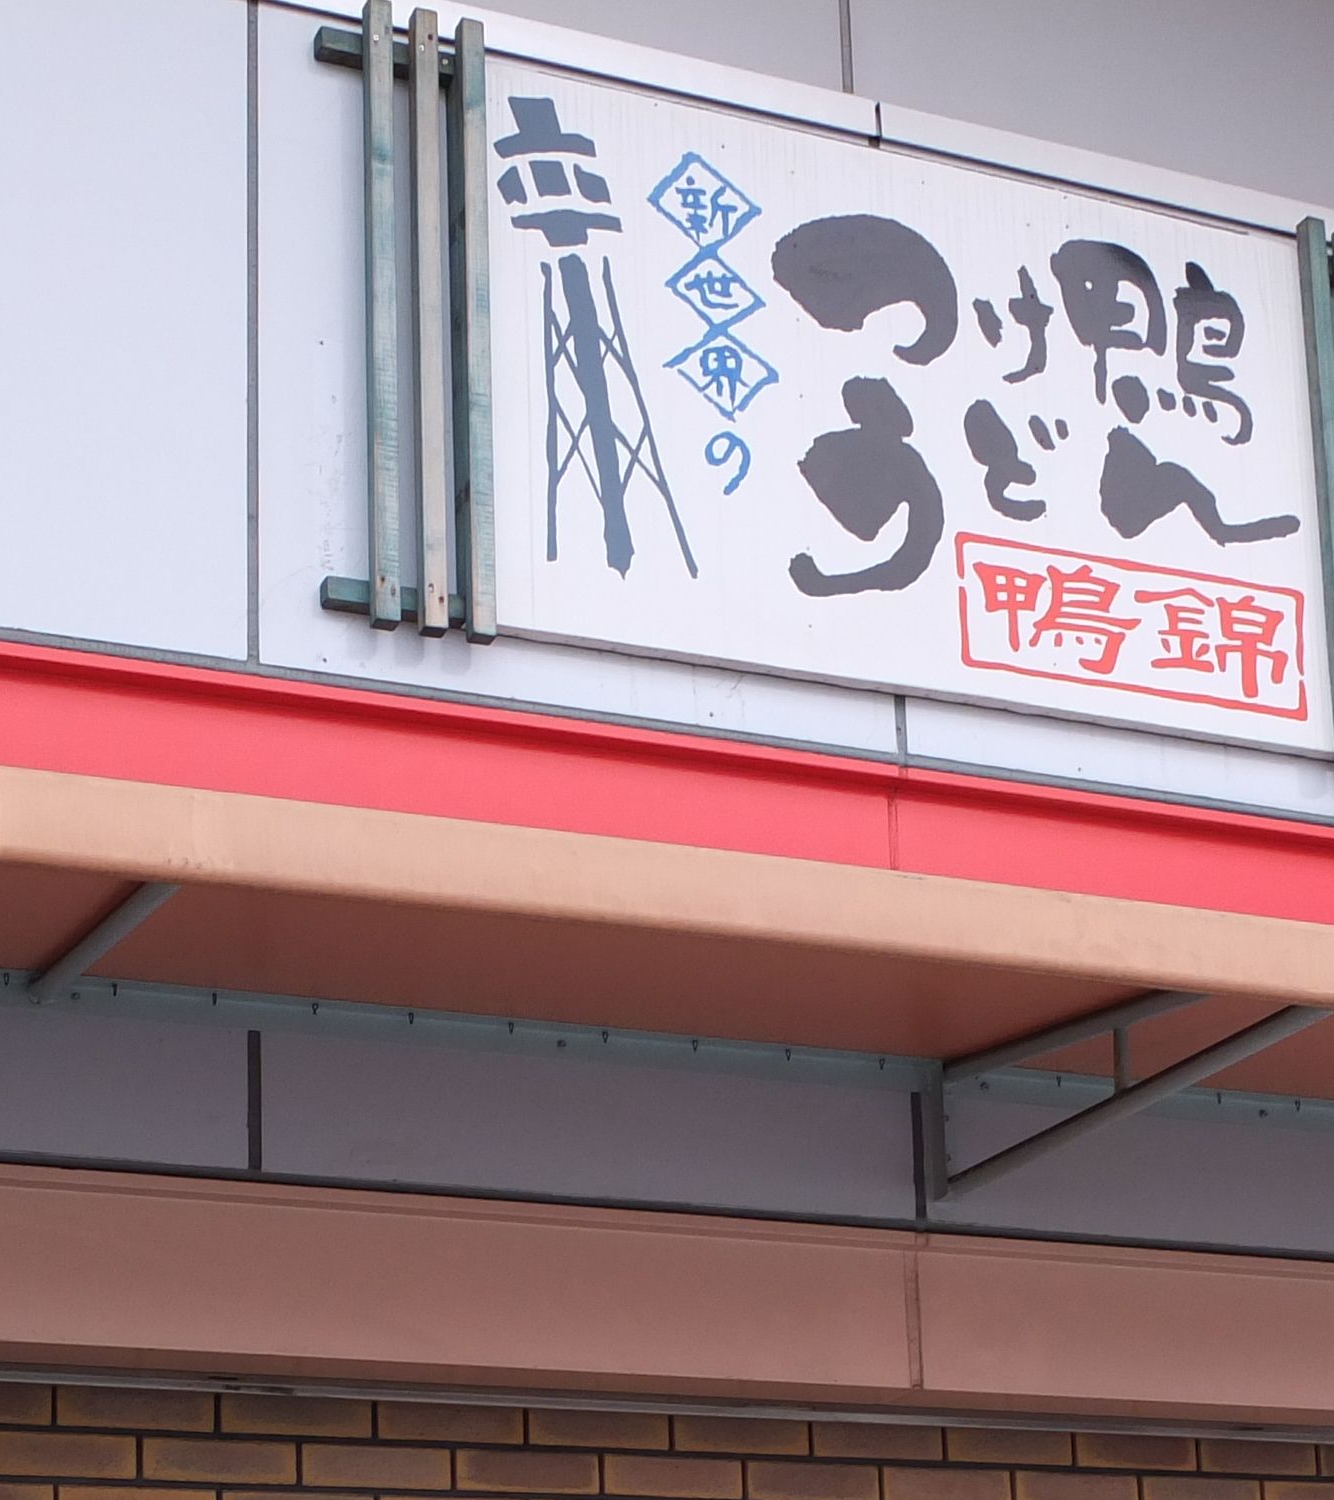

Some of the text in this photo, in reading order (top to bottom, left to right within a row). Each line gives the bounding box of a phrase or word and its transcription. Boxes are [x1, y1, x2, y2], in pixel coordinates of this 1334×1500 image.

[667, 168, 757, 497] 新世界の
[770, 212, 1253, 446] つけ鴨
[788, 375, 1302, 598] うどん
[971, 563, 1288, 698] 鴨錦
